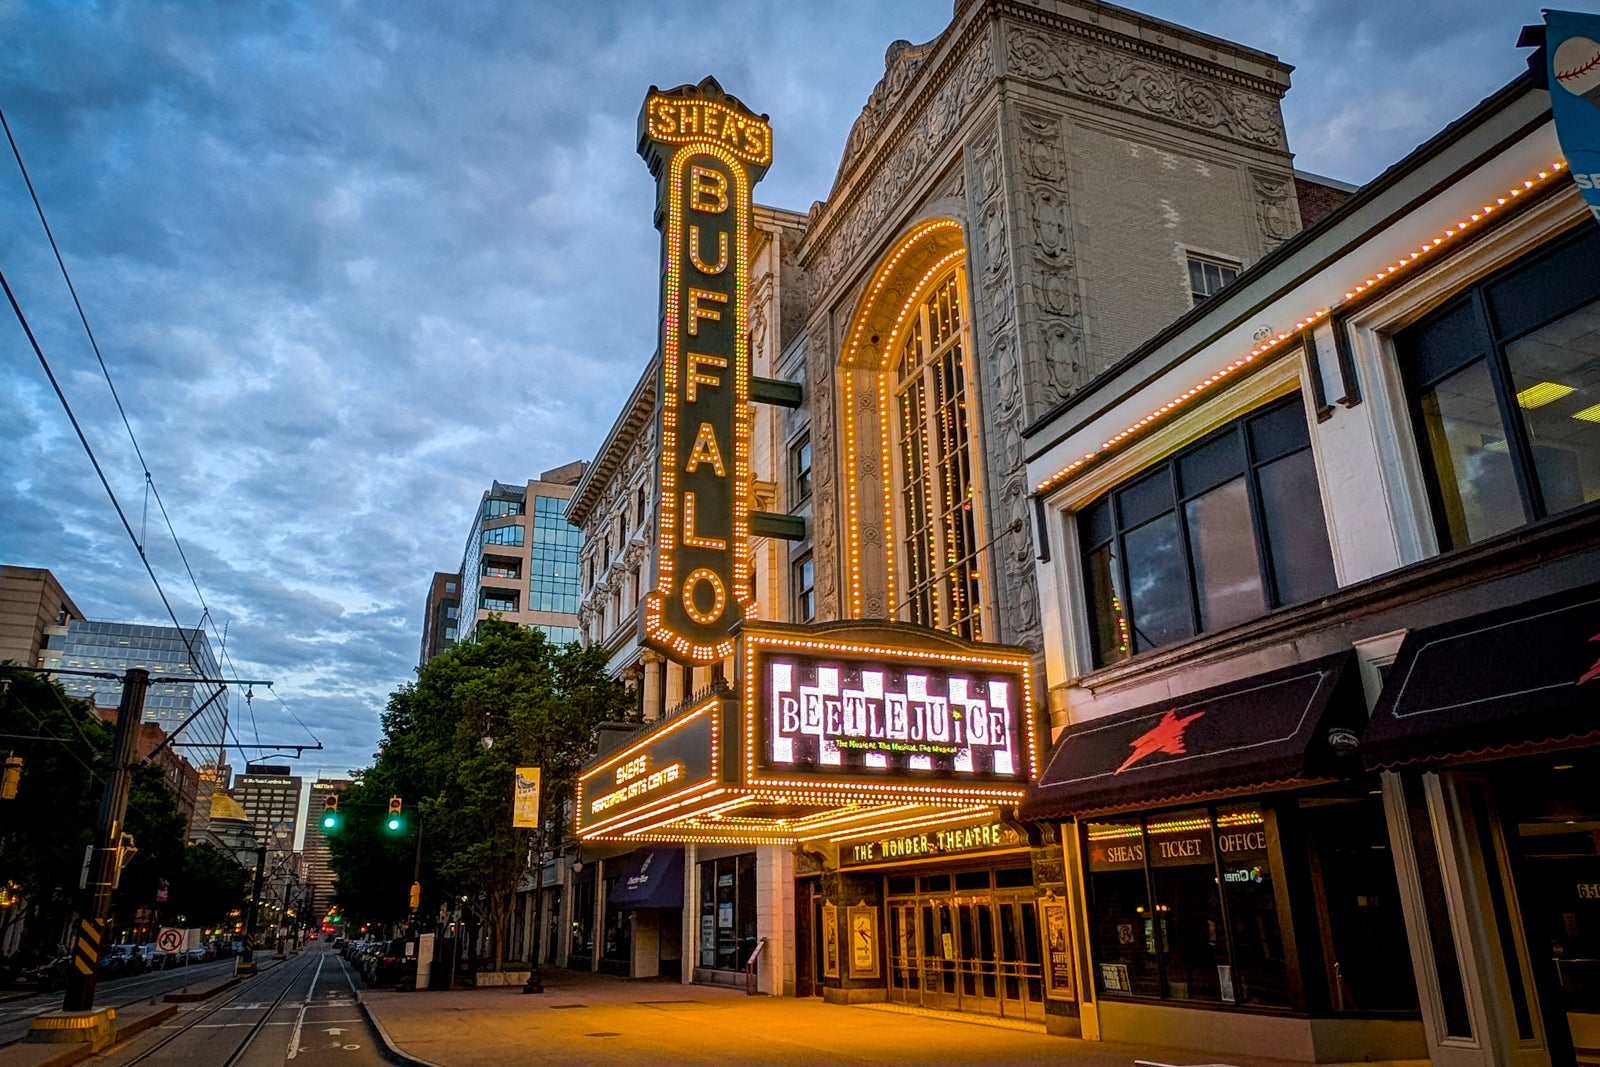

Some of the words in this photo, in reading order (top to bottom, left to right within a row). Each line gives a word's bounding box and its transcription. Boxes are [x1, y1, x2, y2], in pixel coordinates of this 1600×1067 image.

[656, 104, 763, 155] SHEA'S
[682, 165, 729, 625] BUFFALO
[648, 763, 679, 790] CENTER
[854, 843, 873, 861] THE
[936, 823, 1001, 850] THEATRE
[1107, 844, 1143, 863] SHEA'S
[1159, 838, 1202, 859] TICKET
[1218, 831, 1267, 853] OFFICE
